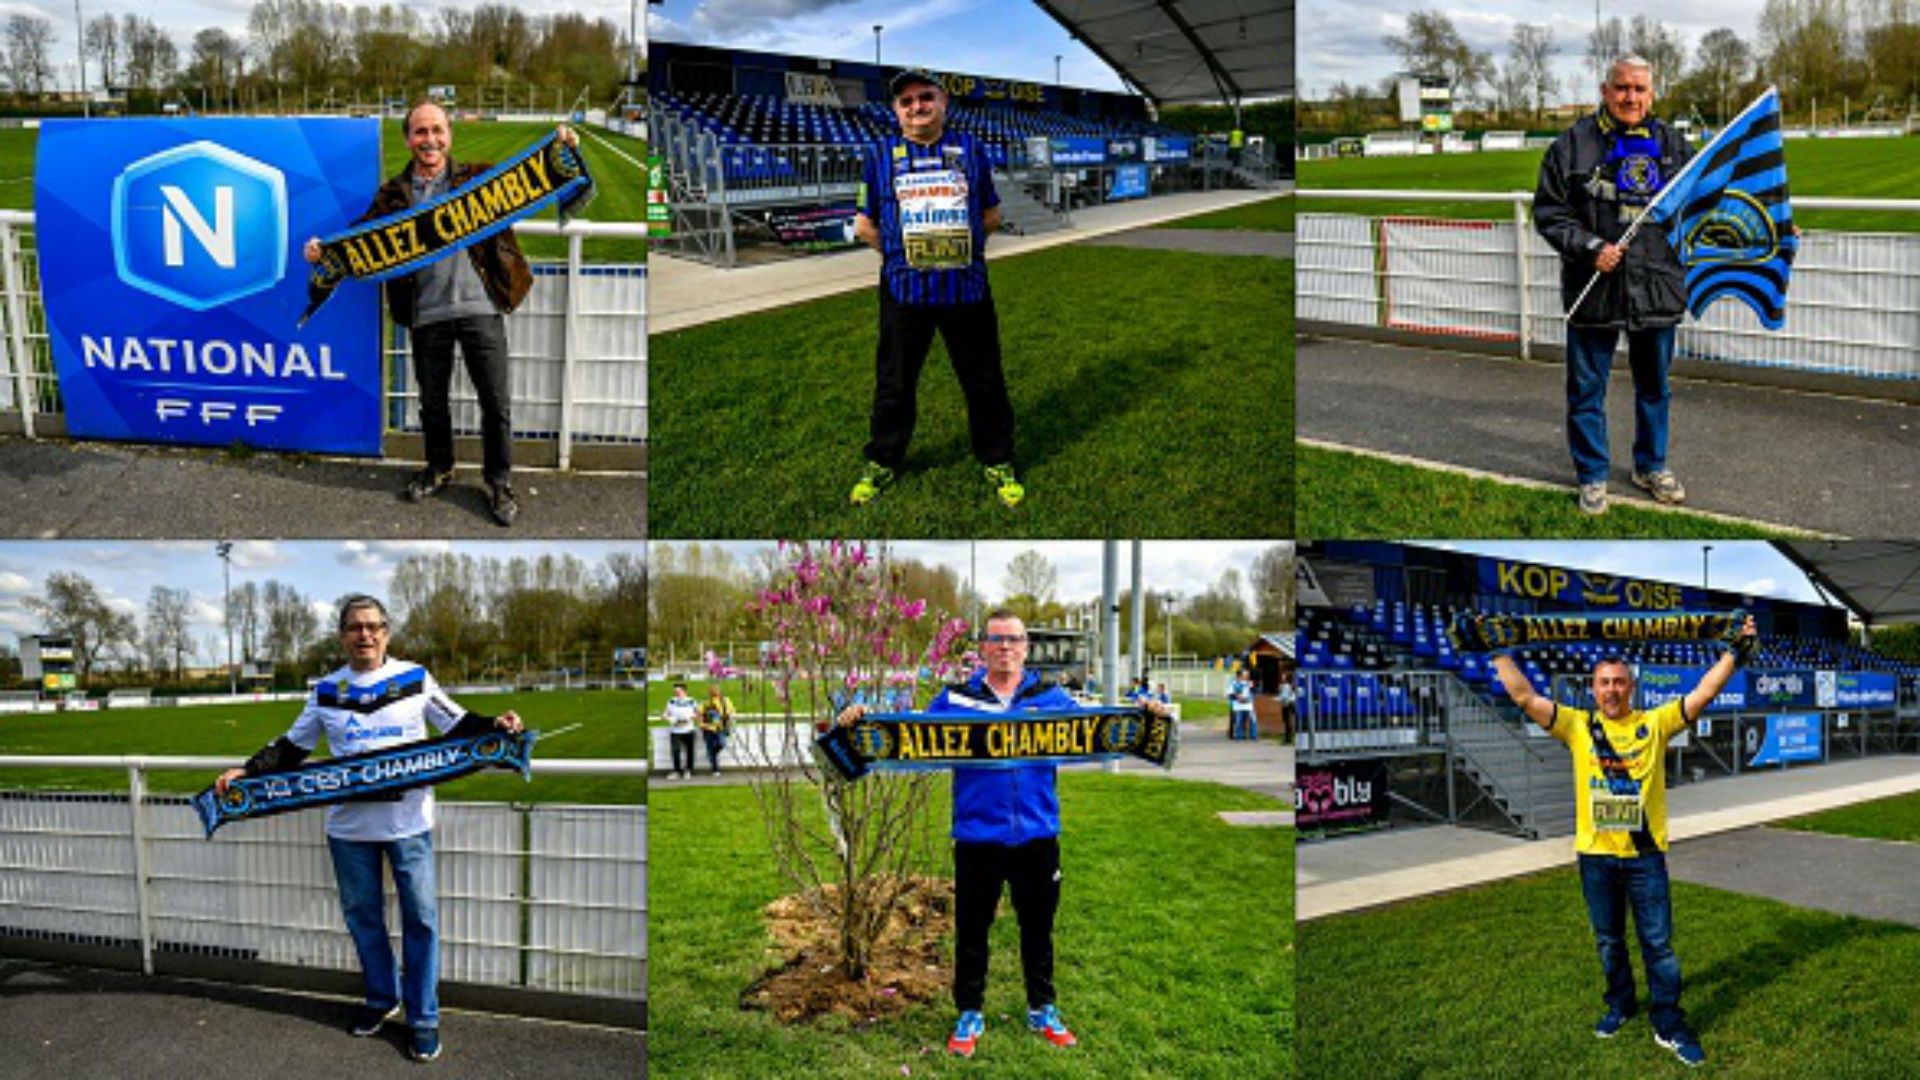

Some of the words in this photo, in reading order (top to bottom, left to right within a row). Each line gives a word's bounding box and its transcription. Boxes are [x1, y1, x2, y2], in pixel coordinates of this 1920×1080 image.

[160, 185, 236, 268] N
[342, 220, 426, 276] ALLEZ
[433, 149, 554, 243] CHAMBLY
[81, 334, 347, 380] NATIONAL
[155, 398, 284, 426] FFF
[1497, 561, 1569, 600] KOP
[1625, 581, 1684, 610] OISE
[1525, 615, 1590, 641] ALLEZ
[1601, 615, 1707, 640] CHAMBLY
[899, 722, 972, 760] ALLEZ
[987, 716, 1100, 758] CHAMBLY
[361, 749, 459, 784] CHAMBLY
